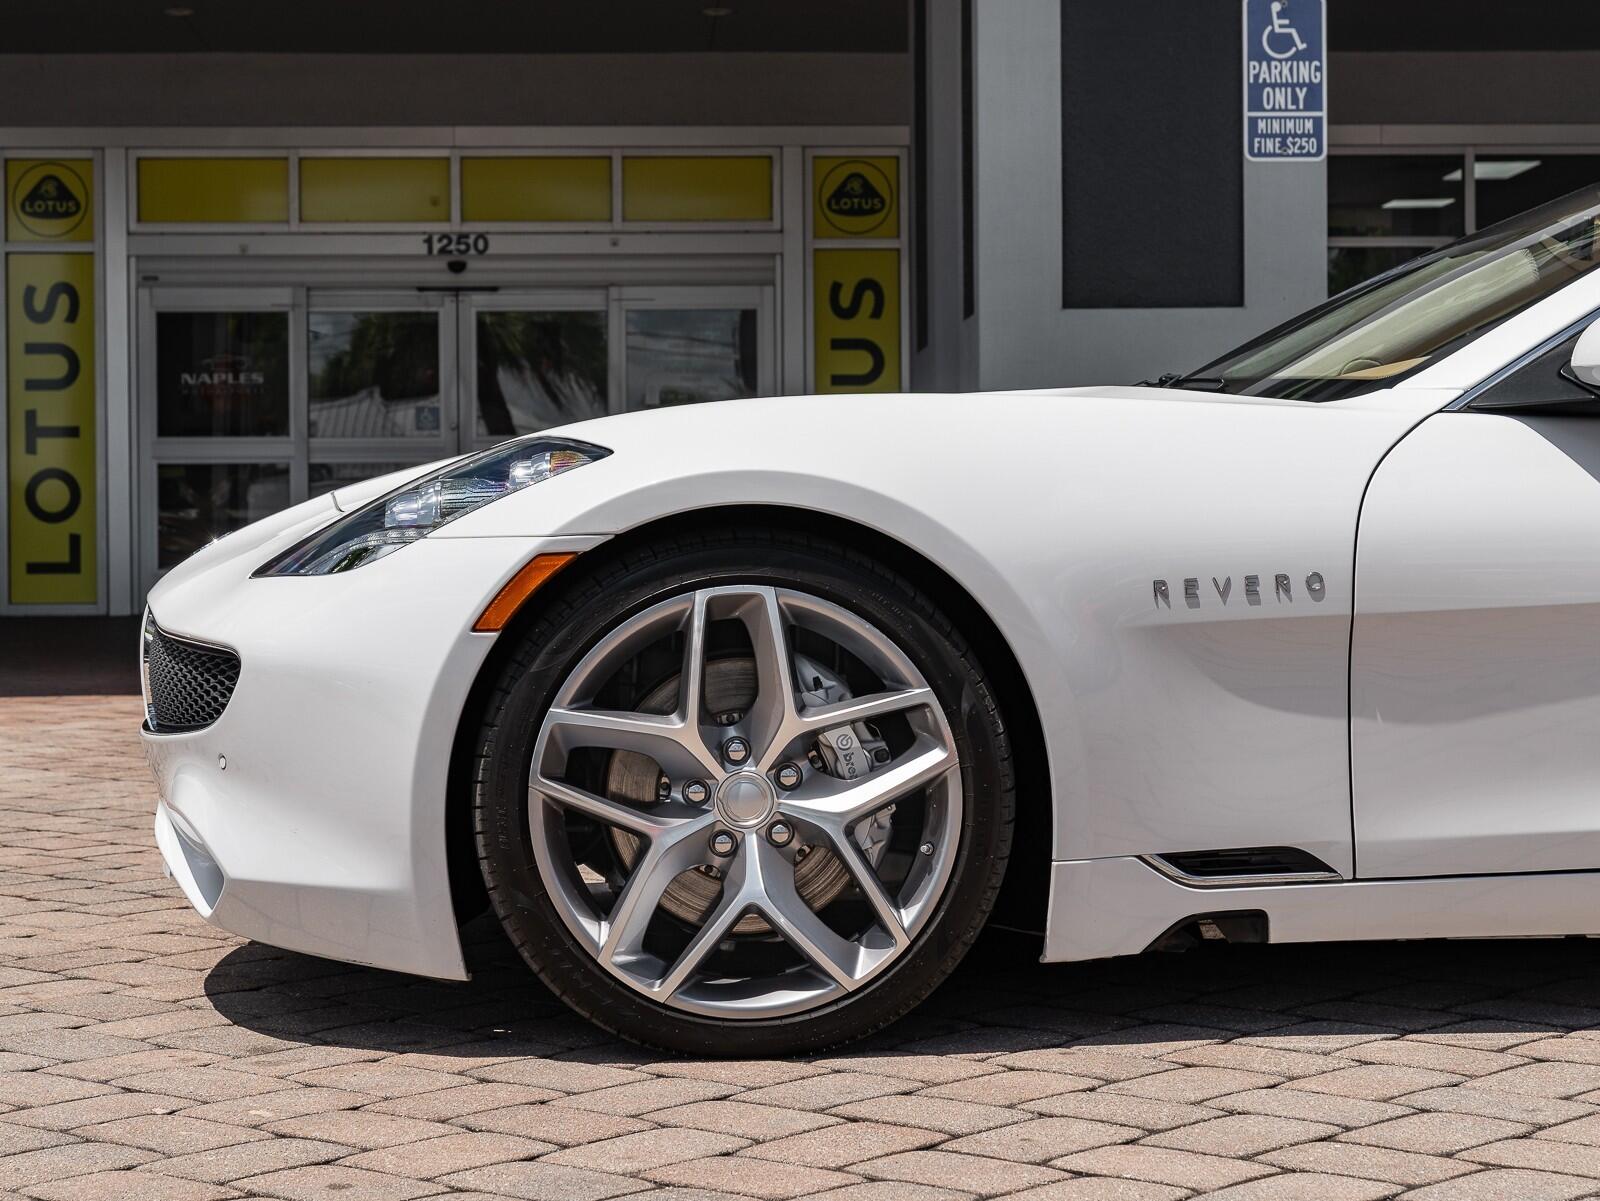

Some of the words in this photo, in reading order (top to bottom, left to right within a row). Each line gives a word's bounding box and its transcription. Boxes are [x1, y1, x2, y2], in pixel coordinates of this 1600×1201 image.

[1249, 60, 1321, 84] PARKING
[1262, 87, 1307, 110] ONLY
[1257, 118, 1313, 134] MINIMUM
[1254, 137, 1282, 153] FINE
[1286, 136, 1317, 155] $250
[24, 200, 78, 214] LOTUS
[831, 197, 883, 210] LOTUS
[422, 233, 489, 255] 1250
[180, 371, 265, 385] NAPLES
[23, 280, 82, 575] LOTUS
[1152, 571, 1325, 602] REVERO
